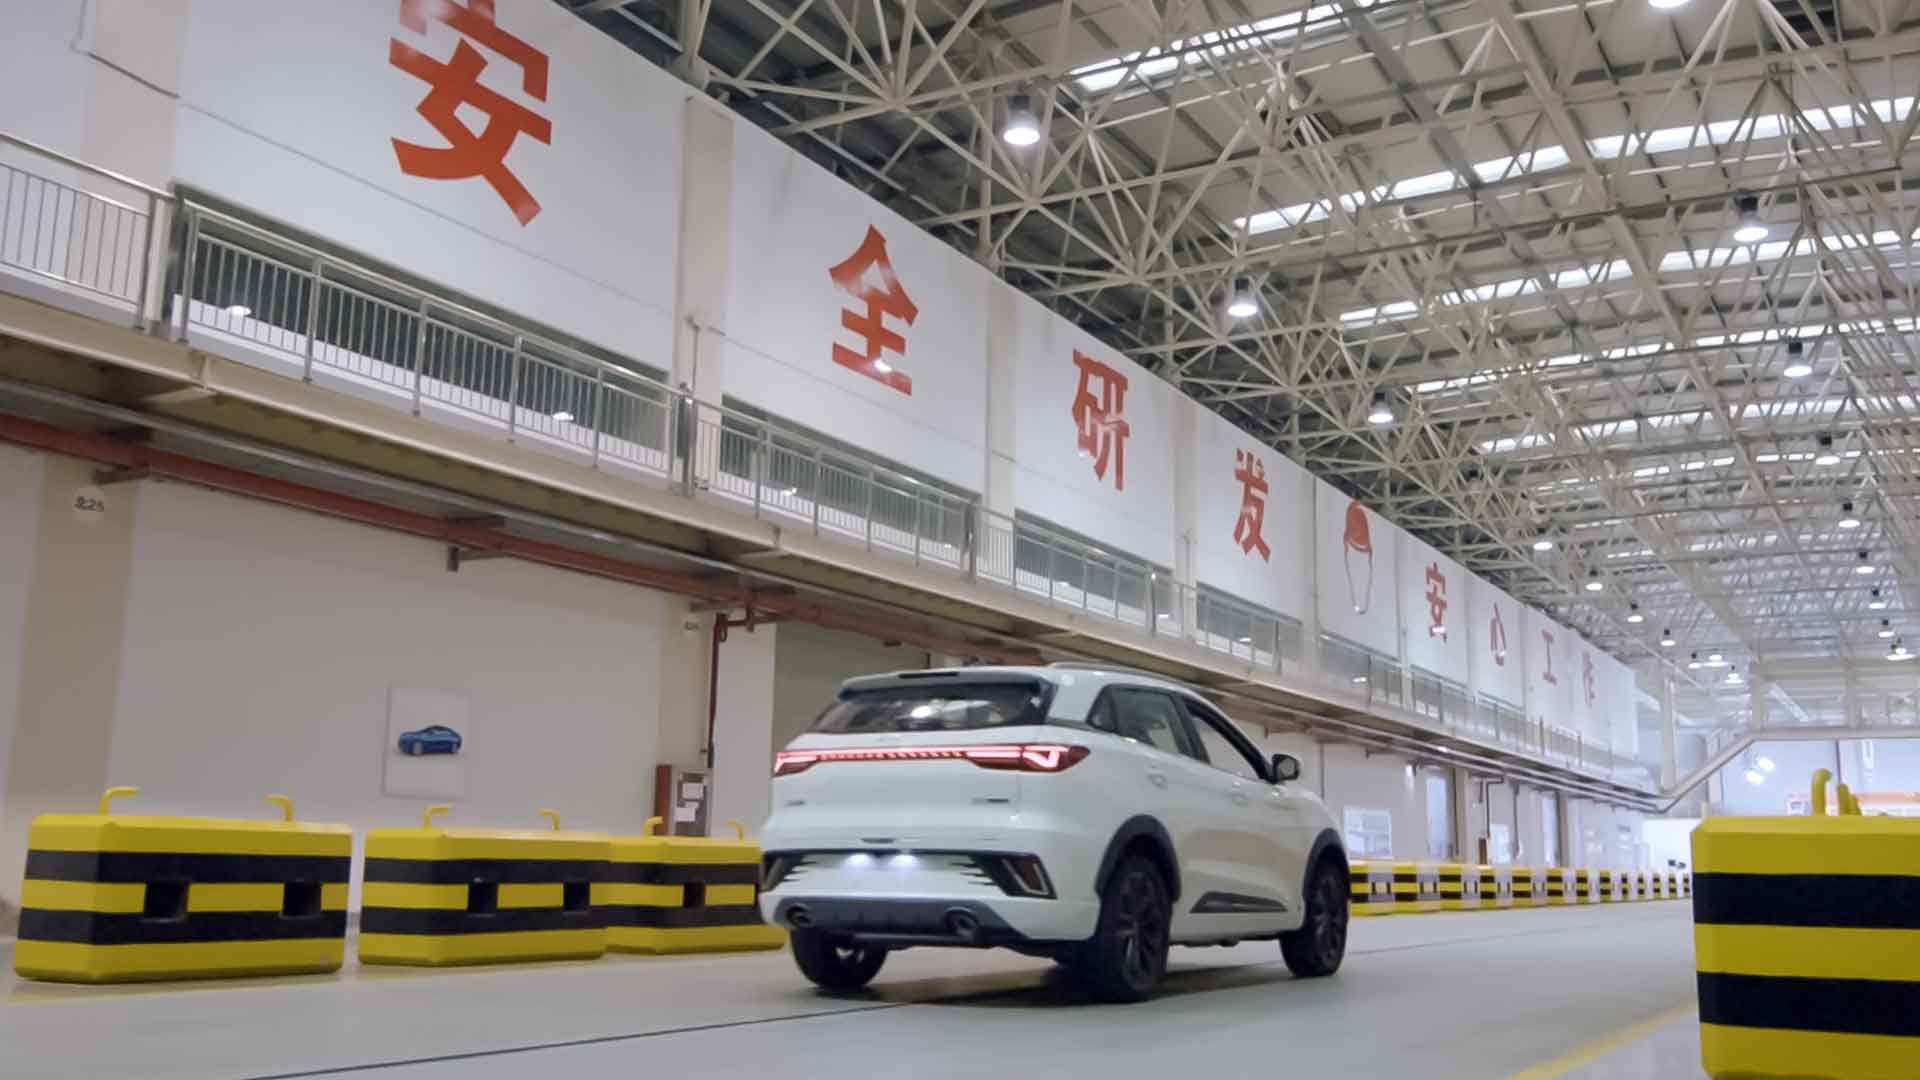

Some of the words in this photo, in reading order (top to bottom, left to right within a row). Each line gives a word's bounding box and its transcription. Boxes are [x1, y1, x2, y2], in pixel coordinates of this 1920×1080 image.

[389, 0, 553, 226] 安
[829, 224, 919, 396] 全
[1071, 349, 1130, 491] 研
[1233, 448, 1271, 563] 发
[1425, 561, 1447, 643] 安
[1490, 602, 1506, 667] 心
[1542, 629, 1557, 686] 工
